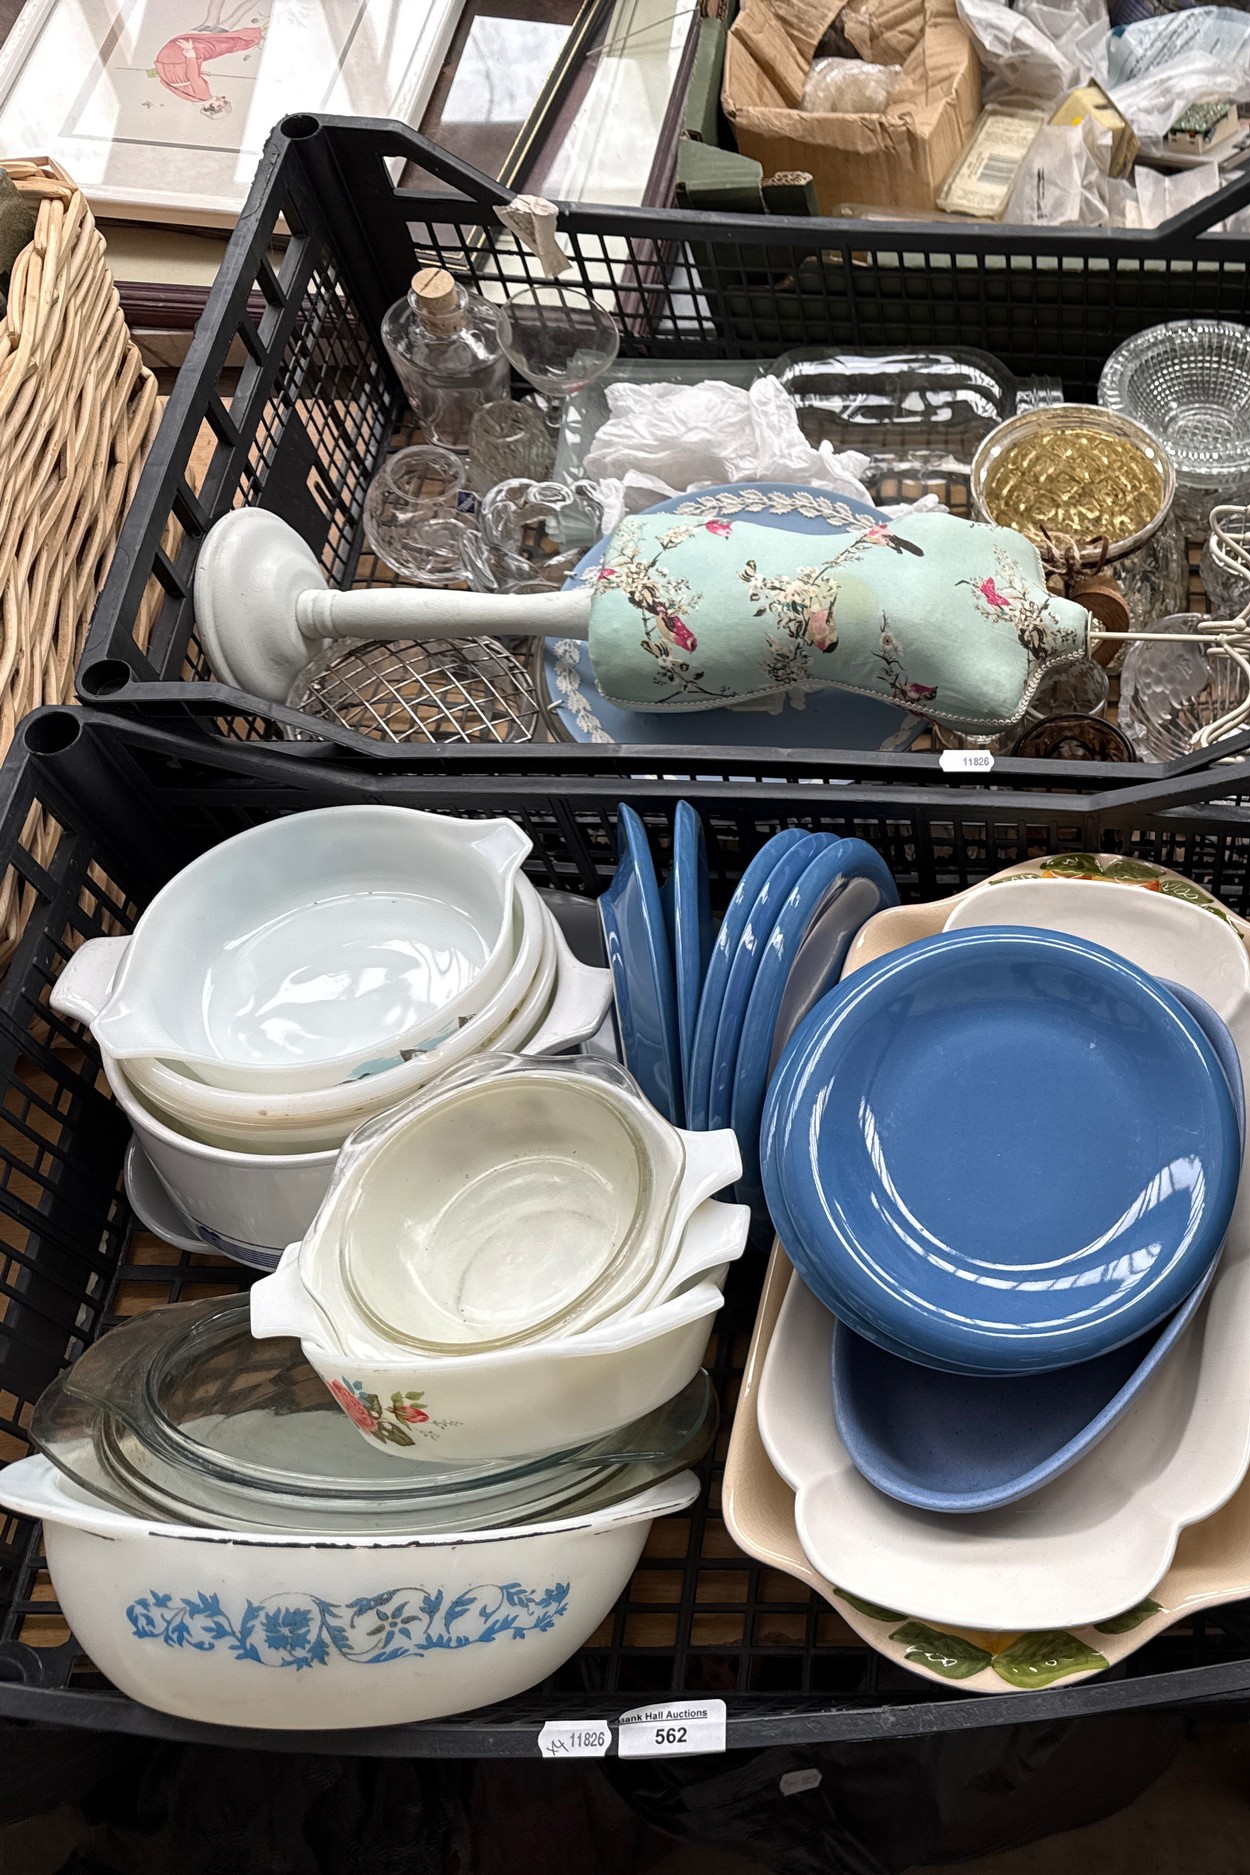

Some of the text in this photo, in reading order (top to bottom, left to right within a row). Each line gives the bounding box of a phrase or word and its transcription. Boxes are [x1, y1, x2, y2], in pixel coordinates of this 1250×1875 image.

[963, 757, 990, 766] 11826
[645, 1711, 664, 1721] Hall
[666, 1709, 708, 1719] Auctions
[570, 1732, 605, 1747] 11826
[655, 1727, 688, 1744] 562
